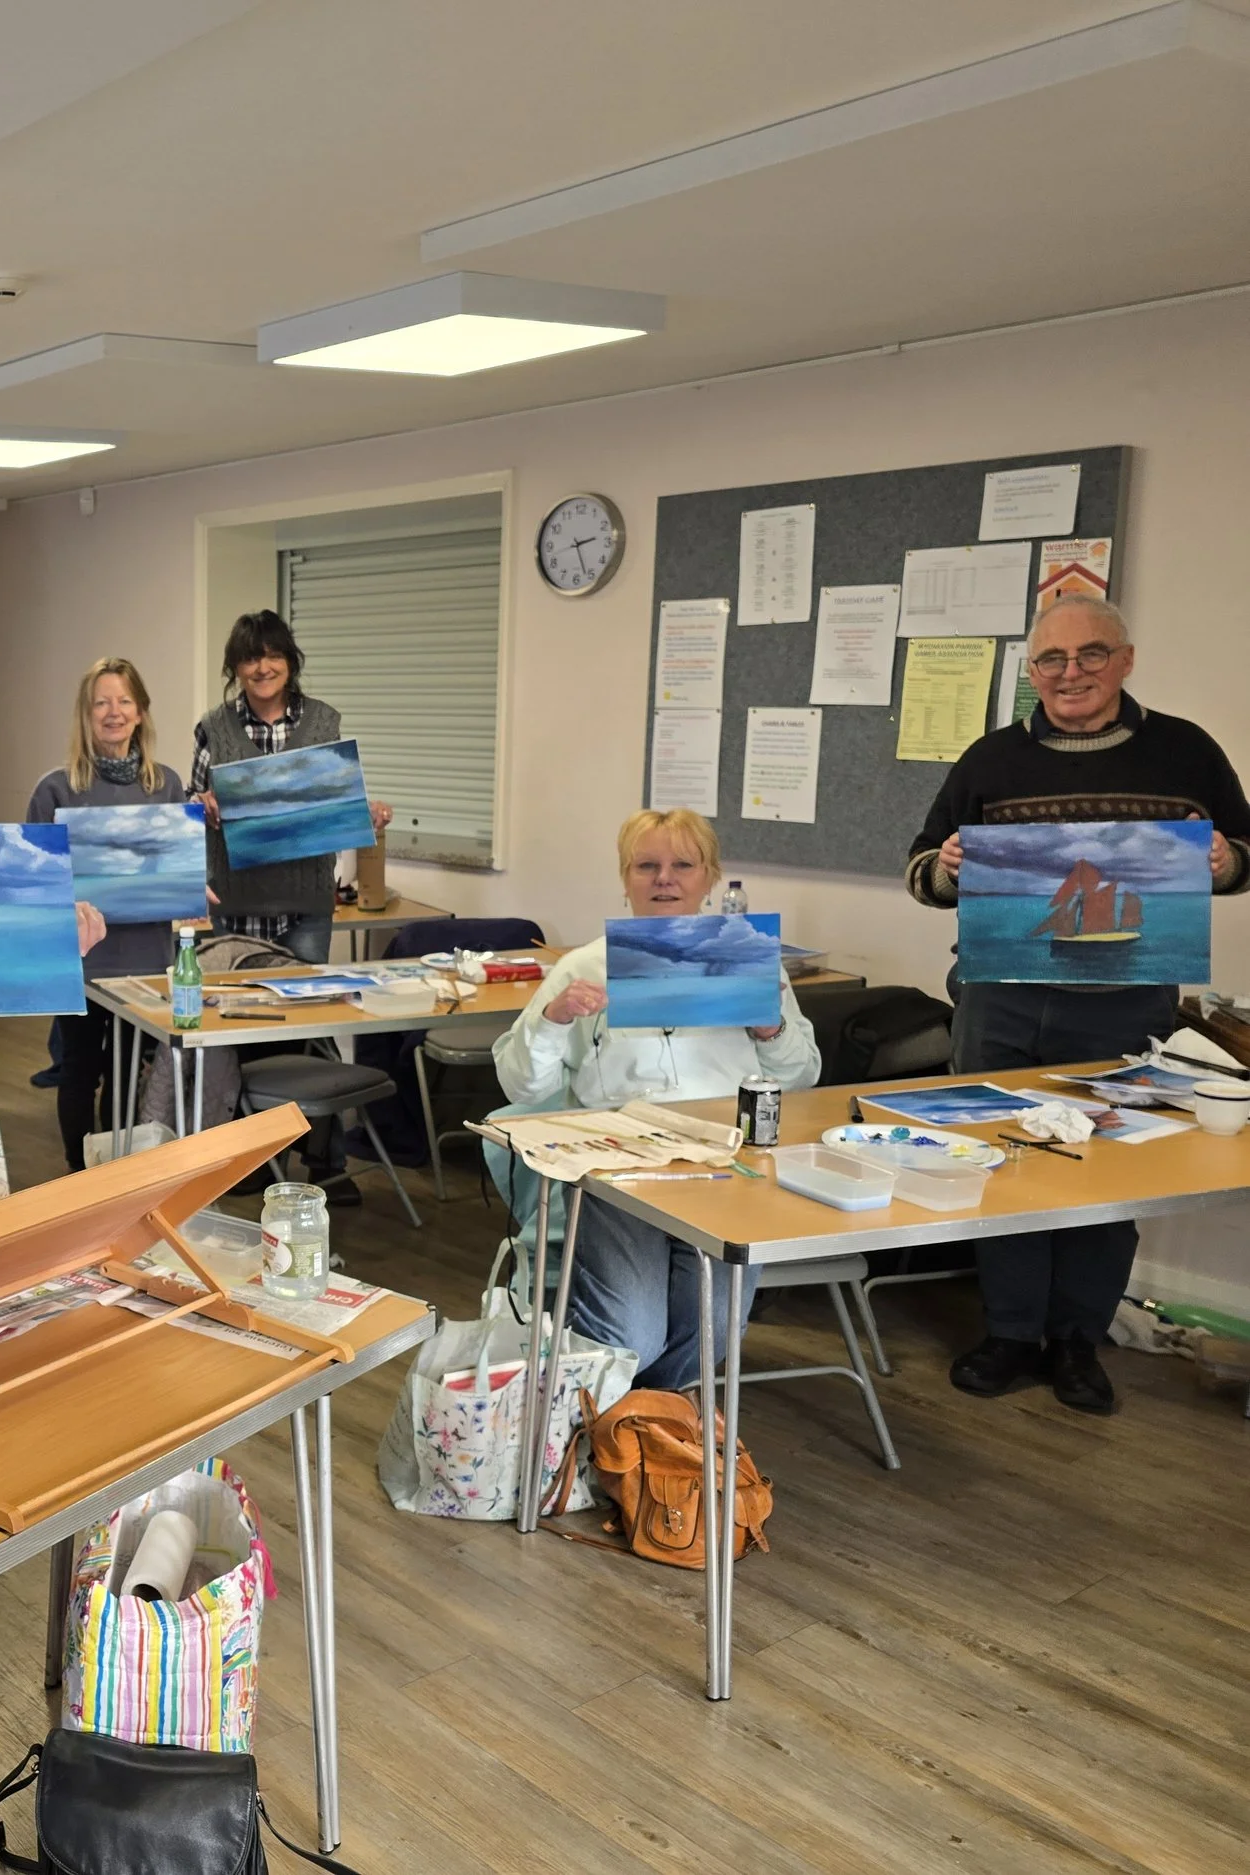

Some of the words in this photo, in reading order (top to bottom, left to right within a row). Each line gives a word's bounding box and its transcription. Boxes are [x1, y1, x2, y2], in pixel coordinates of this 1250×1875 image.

[576, 504, 587, 515] 12
[562, 511, 571, 520] 11
[551, 523, 562, 535] 10
[600, 520, 608, 531] 2
[546, 541, 554, 553] 9
[604, 537, 611, 548] 3
[550, 557, 558, 569] 8
[598, 555, 606, 564] 4
[560, 569, 567, 580] 7
[572, 574, 580, 585] 6
[588, 568, 595, 580] 5
